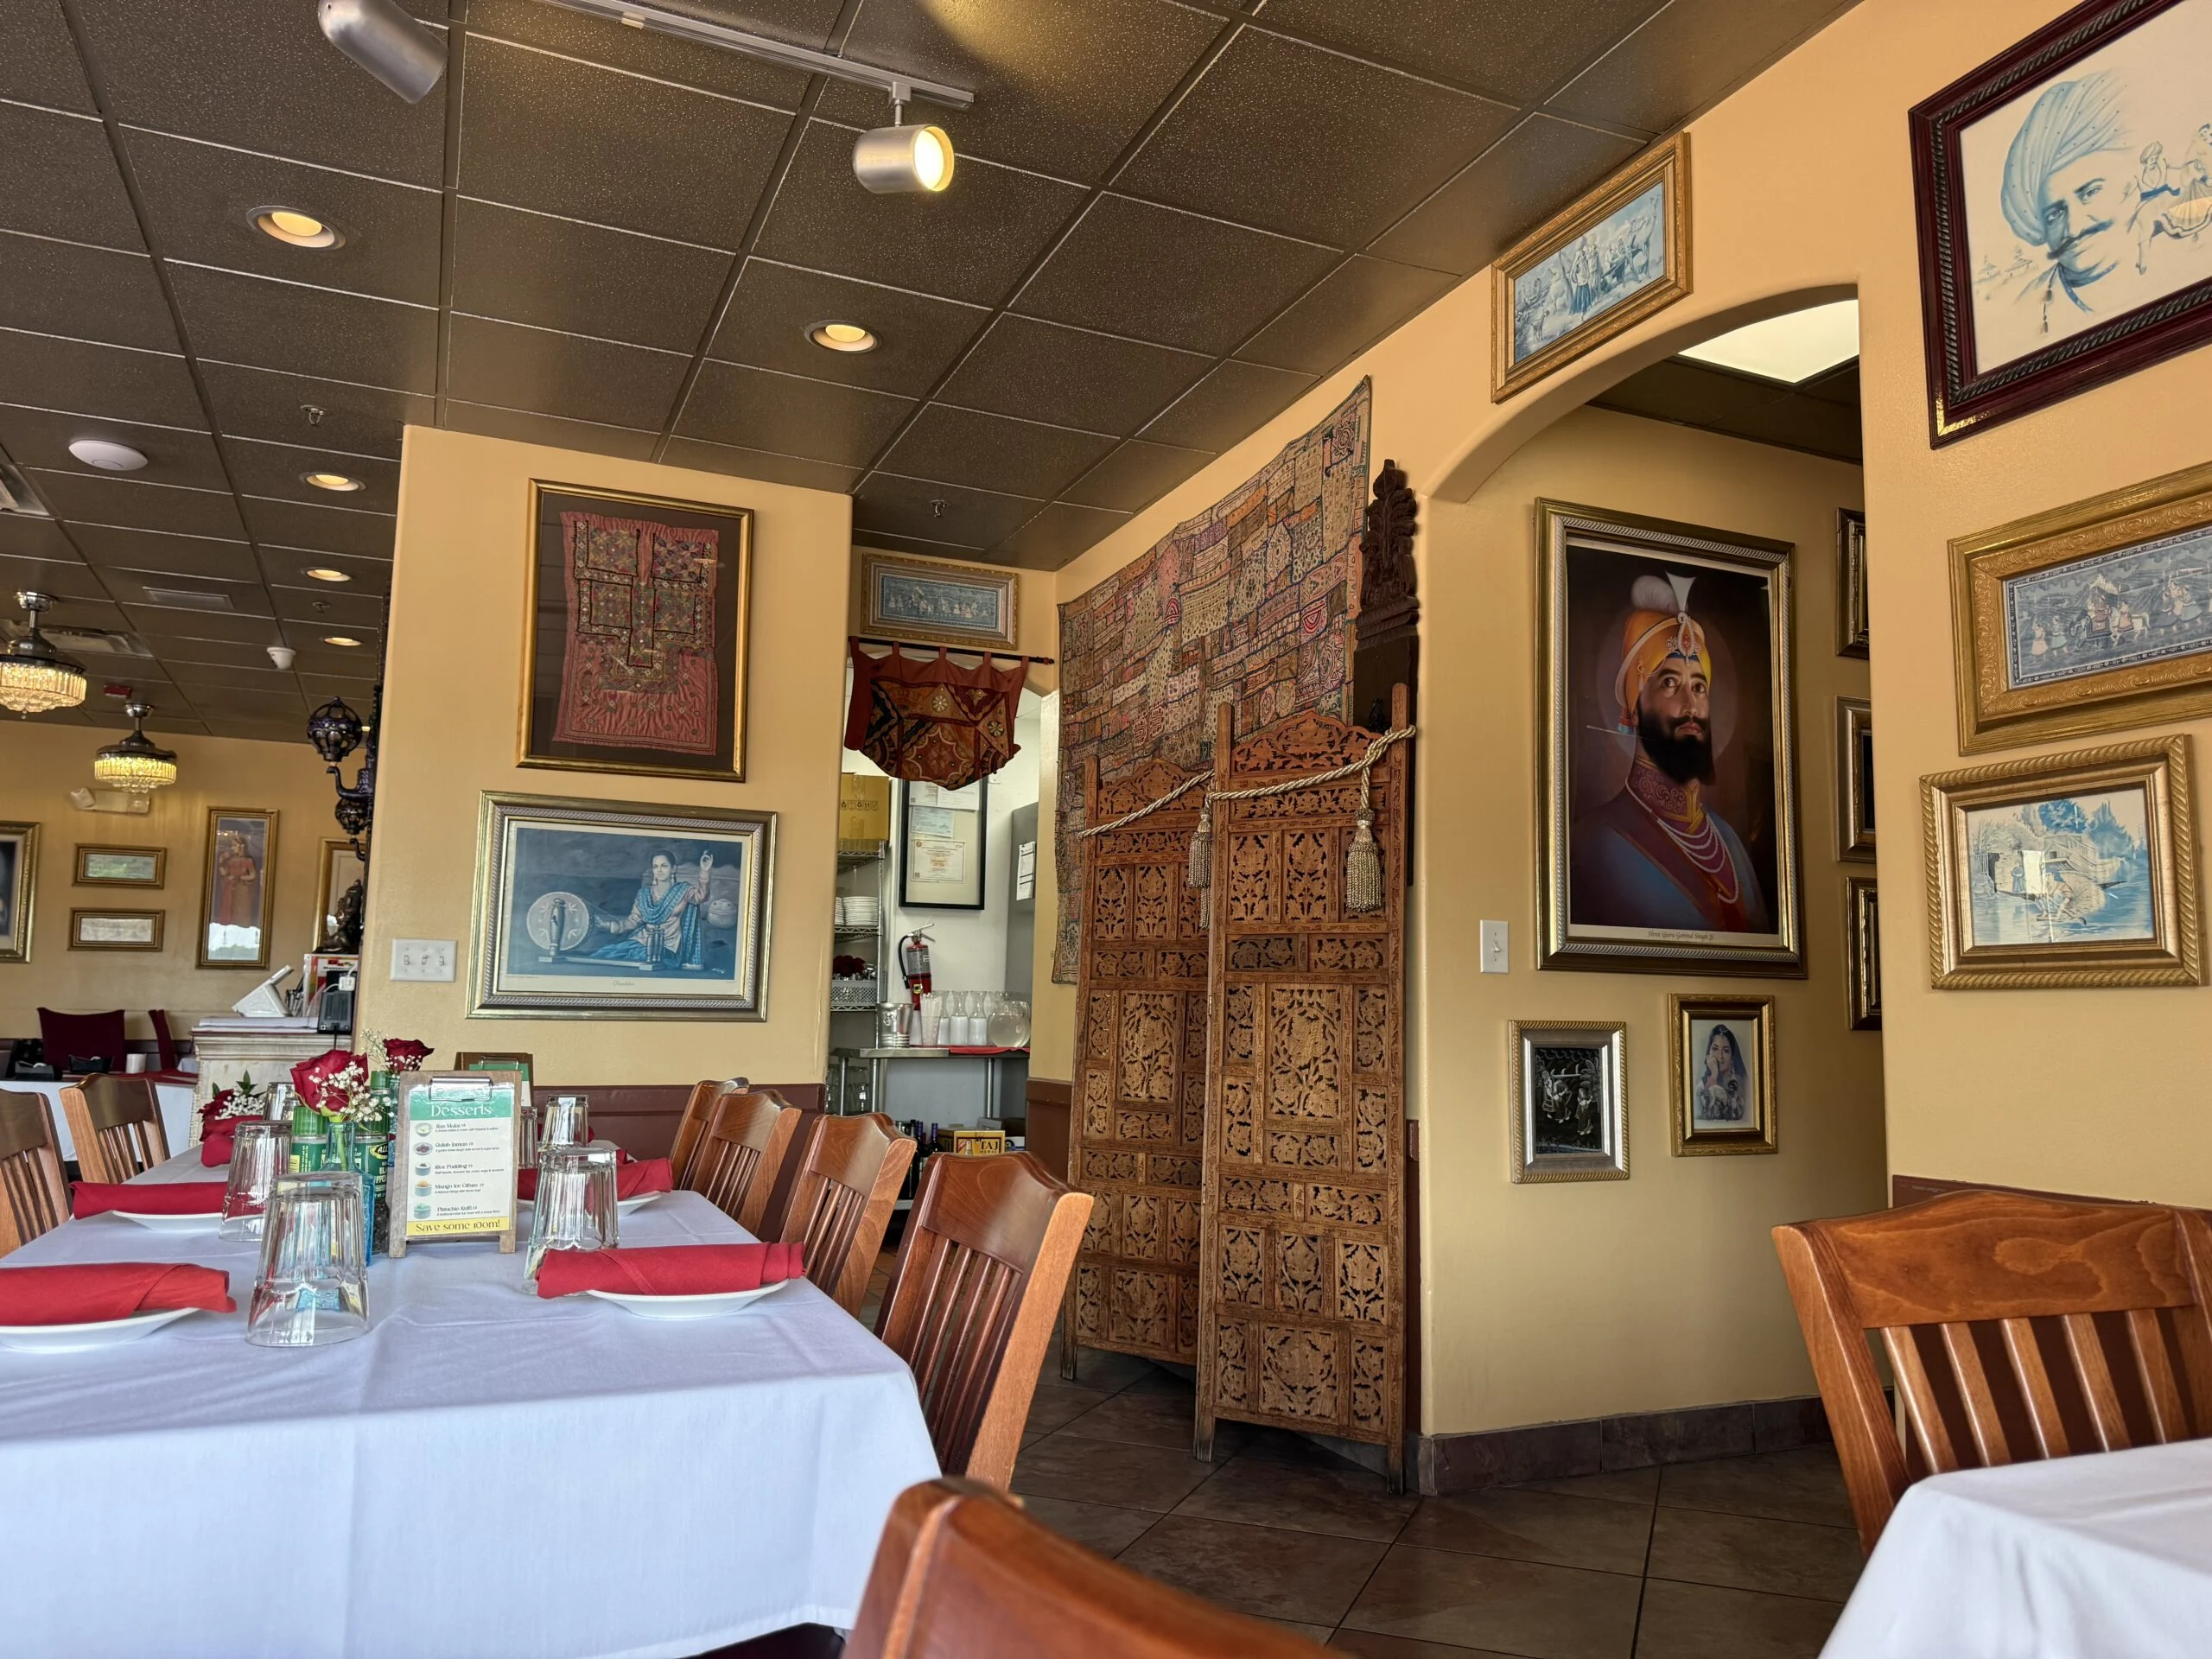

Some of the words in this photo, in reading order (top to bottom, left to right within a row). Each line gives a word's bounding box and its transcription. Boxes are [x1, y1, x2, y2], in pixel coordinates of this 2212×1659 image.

[431, 1103, 492, 1117] Desserts
[982, 1141, 999, 1151] TAJ
[416, 1223, 441, 1232] Save
[443, 1223, 470, 1231] some
[474, 1219, 501, 1230] room!
